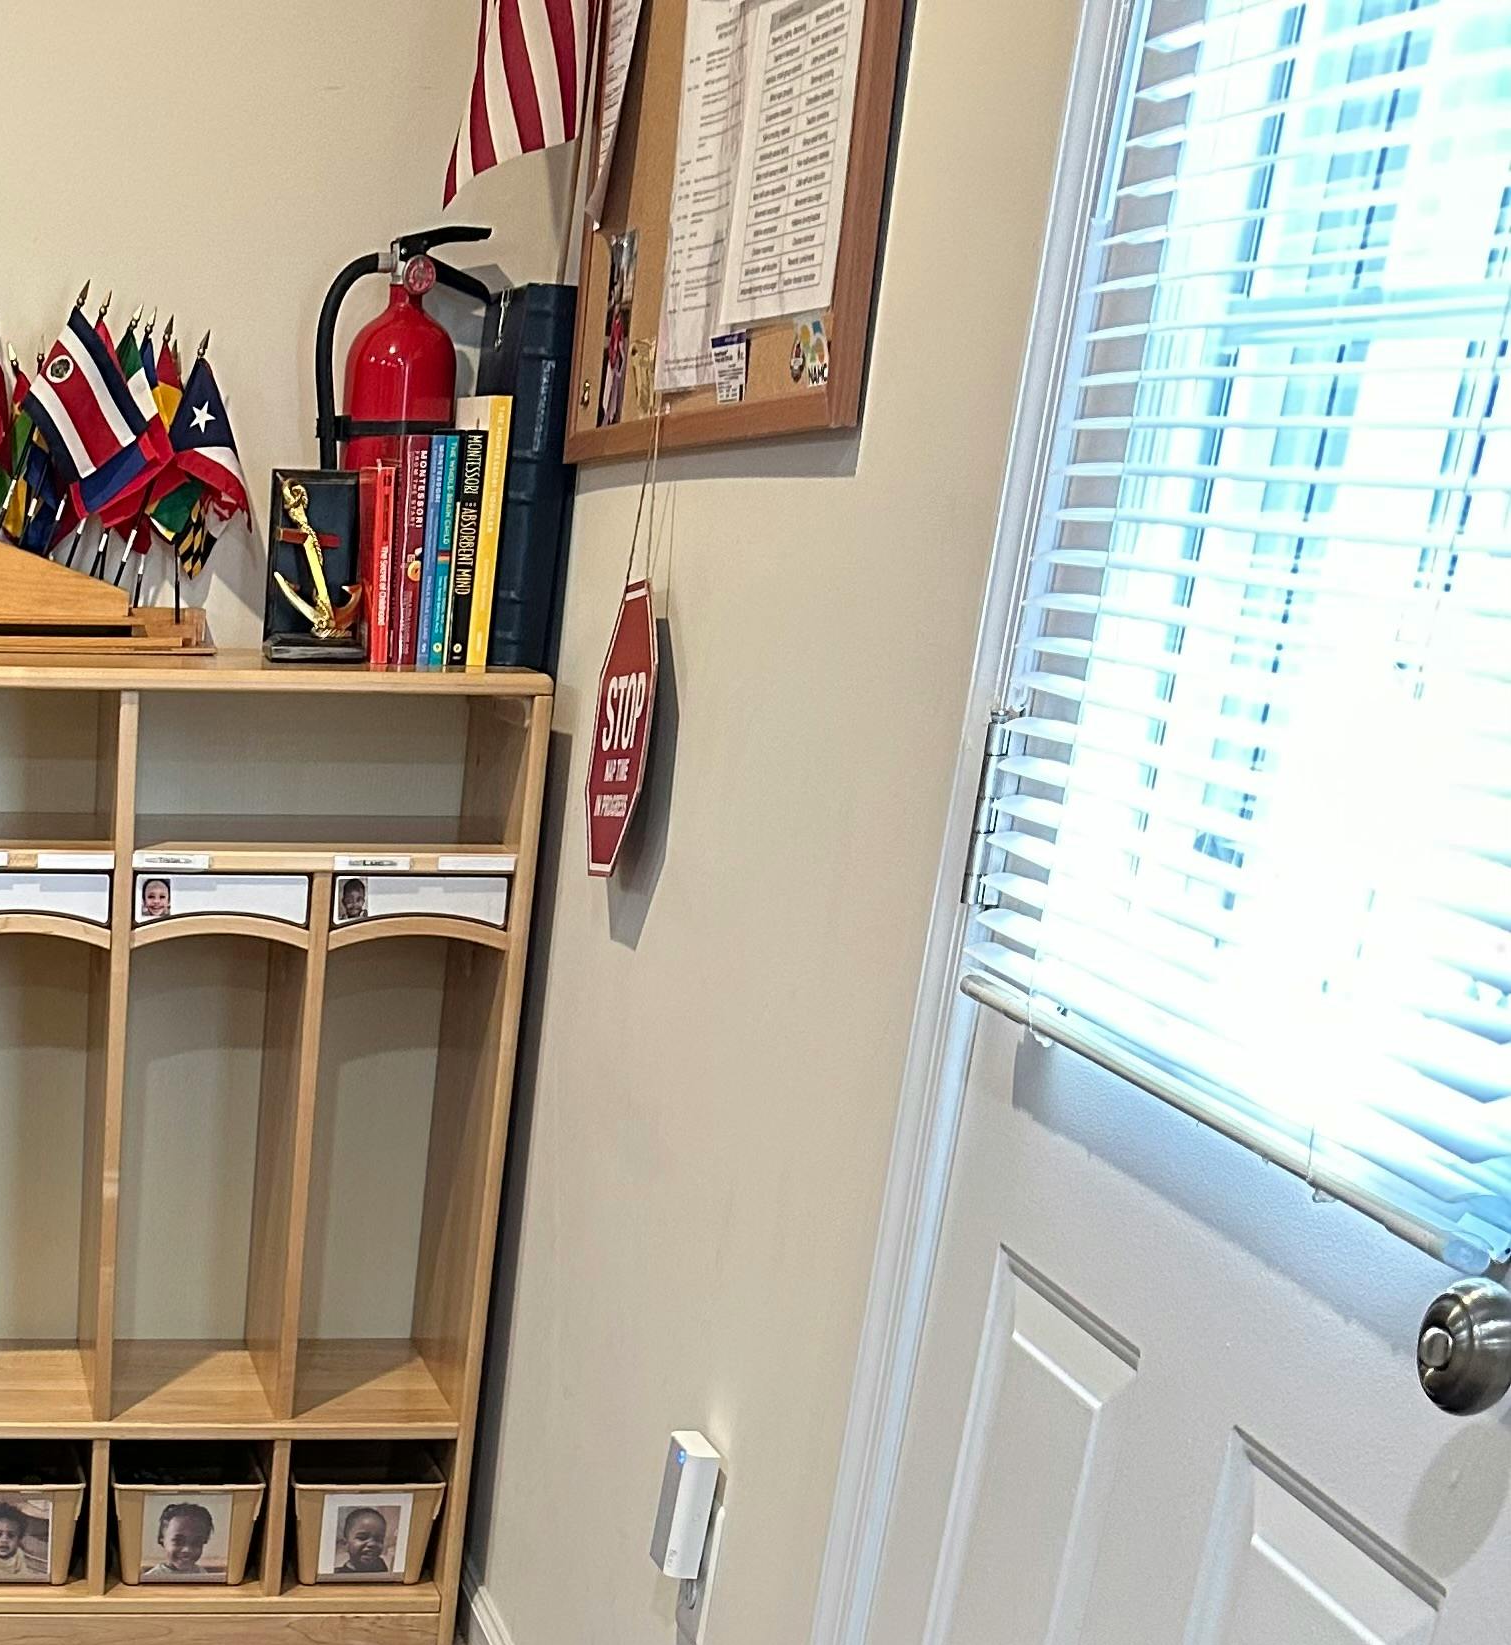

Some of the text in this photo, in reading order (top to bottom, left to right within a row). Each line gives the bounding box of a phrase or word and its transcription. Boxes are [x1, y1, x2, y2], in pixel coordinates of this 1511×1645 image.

[412, 450, 420, 473] FROM
[449, 441, 458, 458] THE
[435, 443, 445, 503] MONTESSORI
[463, 434, 484, 495] MONTESSORI
[415, 450, 428, 528] MONTESSORI
[409, 499, 417, 527] START
[442, 519, 452, 545] CHILD
[457, 507, 478, 567] ABSORBENT
[380, 546, 389, 559] The
[379, 559, 388, 582] Secret
[454, 568, 473, 596] MIND
[379, 582, 387, 591] of
[377, 591, 387, 626] Childhood
[601, 671, 647, 752] STOP
